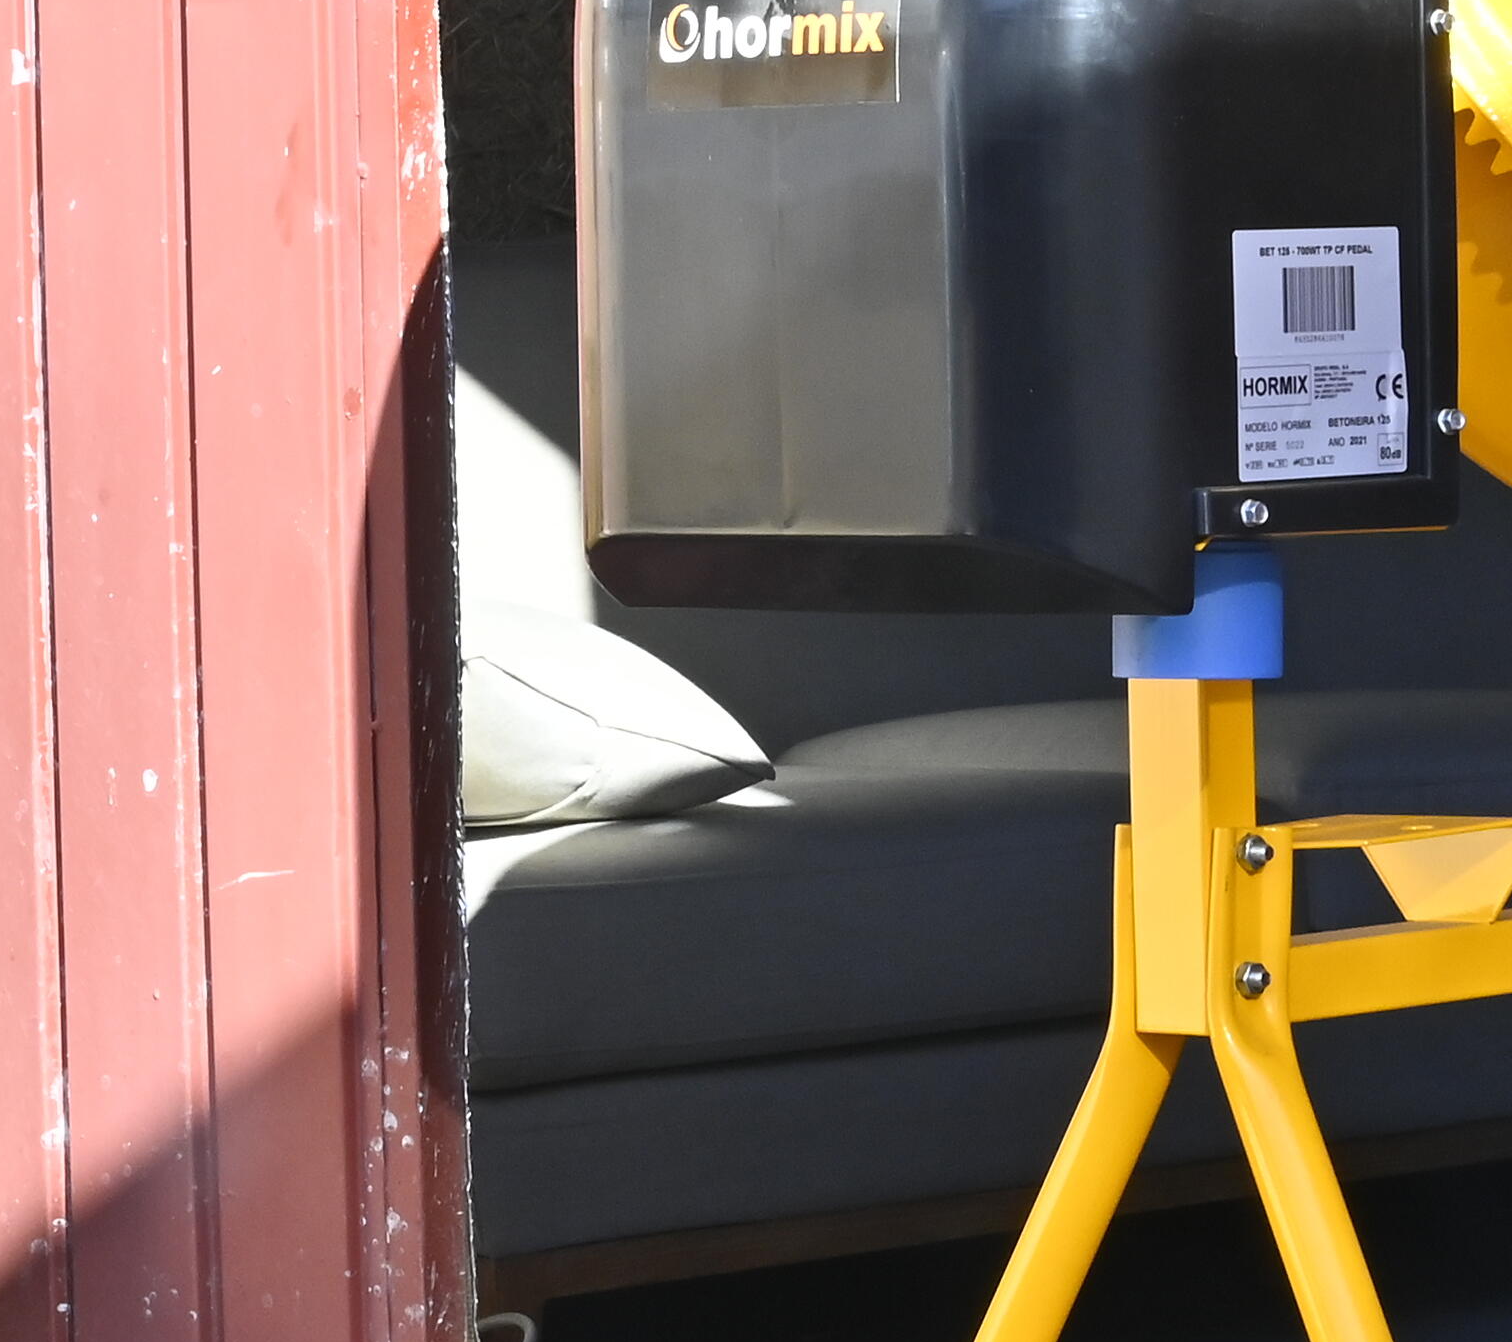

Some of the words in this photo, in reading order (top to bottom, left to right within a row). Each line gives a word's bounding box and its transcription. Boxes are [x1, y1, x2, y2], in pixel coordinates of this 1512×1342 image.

[1259, 246, 1275, 257] BET
[1347, 244, 1373, 255] PEDAL
[1243, 374, 1308, 397] HORMIX
[1245, 421, 1278, 433] MODELO
[1281, 419, 1312, 431] HORMIX
[1328, 415, 1375, 428] BETONEIRA
[1255, 440, 1277, 452] SERIE
[1328, 437, 1345, 447] ANO
[1349, 436, 1368, 445] 2021
